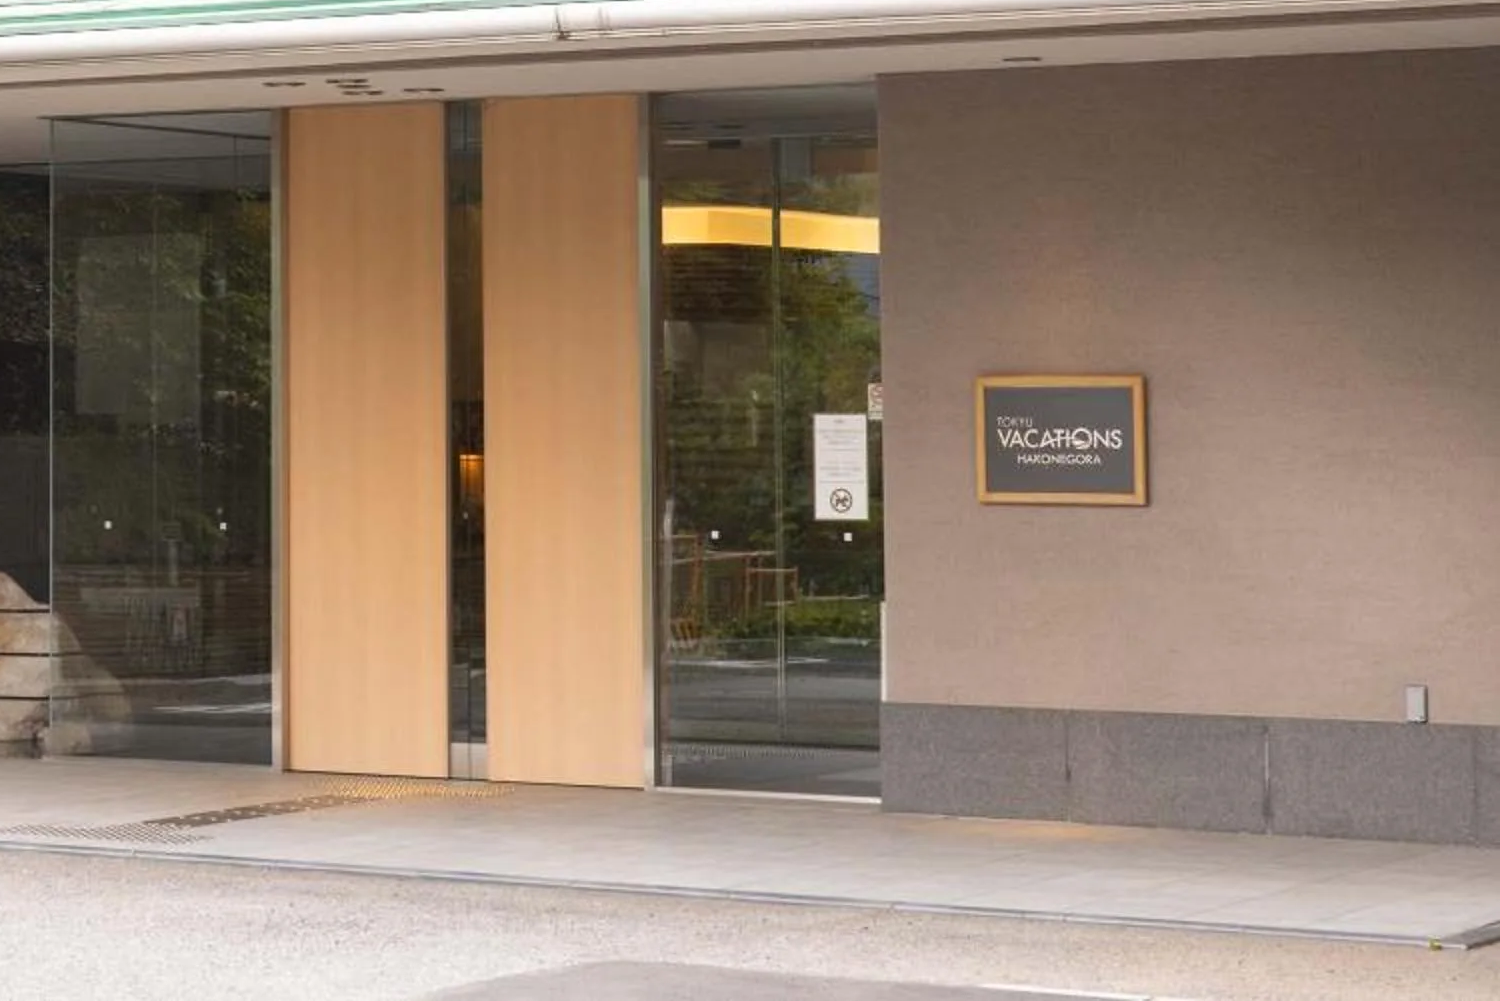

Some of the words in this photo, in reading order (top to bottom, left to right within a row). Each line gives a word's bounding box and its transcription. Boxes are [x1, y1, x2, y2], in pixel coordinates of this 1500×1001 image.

[996, 416, 1033, 428] TOKYU
[997, 427, 1123, 449] VACATIONS
[1016, 453, 1102, 465] HAKONEGORA
